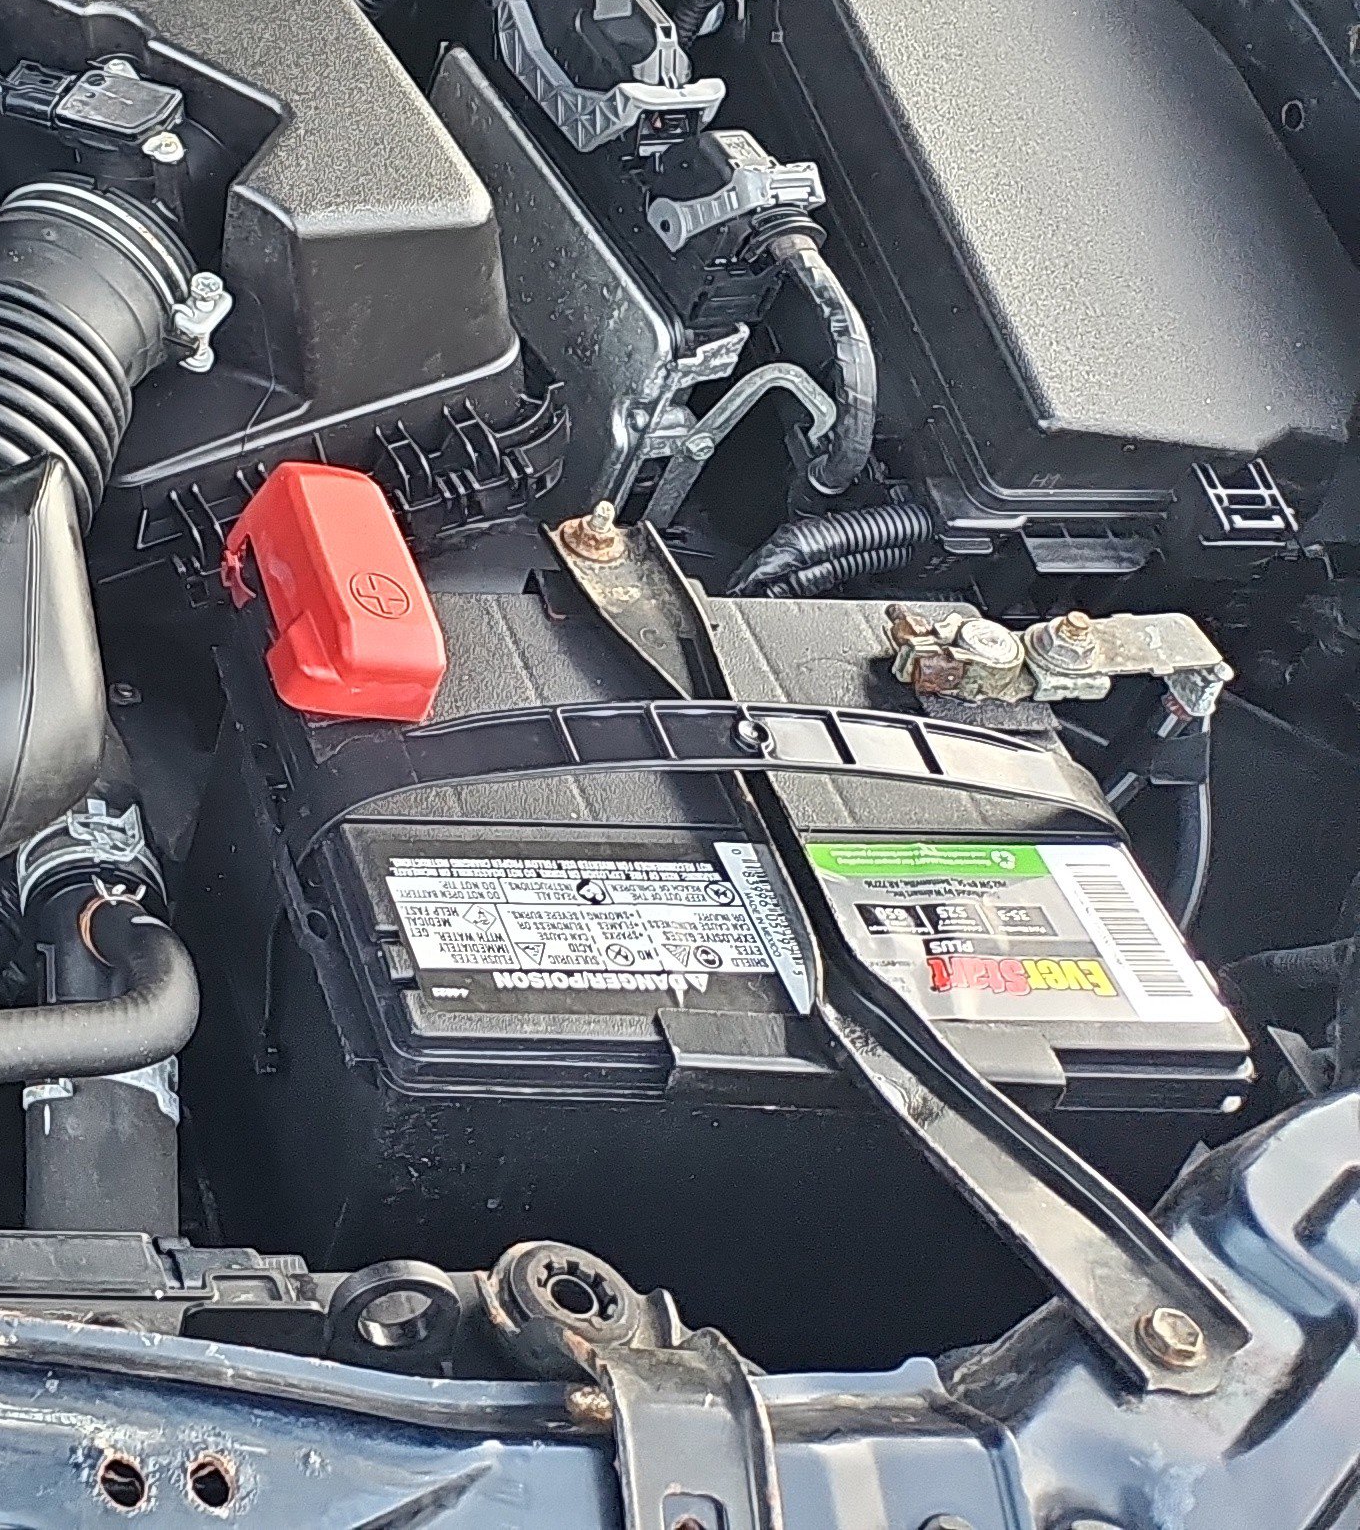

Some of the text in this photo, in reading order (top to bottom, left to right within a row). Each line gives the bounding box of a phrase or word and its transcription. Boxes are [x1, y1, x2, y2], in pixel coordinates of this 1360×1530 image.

[439, 881, 496, 889] DO NOT TIP.
[504, 882, 573, 891] INSTRUCTIONS.
[670, 884, 701, 892] REACH
[396, 890, 500, 900] DO NOT OPEN BATTERY.
[534, 892, 577, 900] READ ALL
[631, 892, 706, 902] KEEP OUT OF THE
[400, 906, 459, 916] HELP FAST.
[936, 906, 966, 918] 525
[404, 917, 451, 927] MEDICAL
[731, 913, 744, 921] OR
[517, 921, 584, 930] BLINDNESS OR
[701, 921, 729, 930] CAUSE
[731, 922, 749, 931] CAN
[744, 891, 760, 915] MADE
[760, 926, 782, 958] MEXICO
[410, 928, 429, 937] GET
[434, 932, 505, 942] WITH WATER.
[537, 932, 567, 941] CAUSE
[662, 931, 756, 943] EXPLOSIVE GASES
[439, 943, 509, 953] IMMEDIATELY
[568, 943, 592, 953] ACID
[730, 945, 762, 955] EYES.
[928, 939, 973, 954] PLUS
[451, 953, 514, 965] FLUSH EYES
[548, 954, 599, 965] SULFURIC
[637, 950, 653, 960] NO
[731, 958, 768, 968] SHIELD
[492, 972, 687, 990] DANGER/POISON
[926, 956, 1117, 997] EverStart
